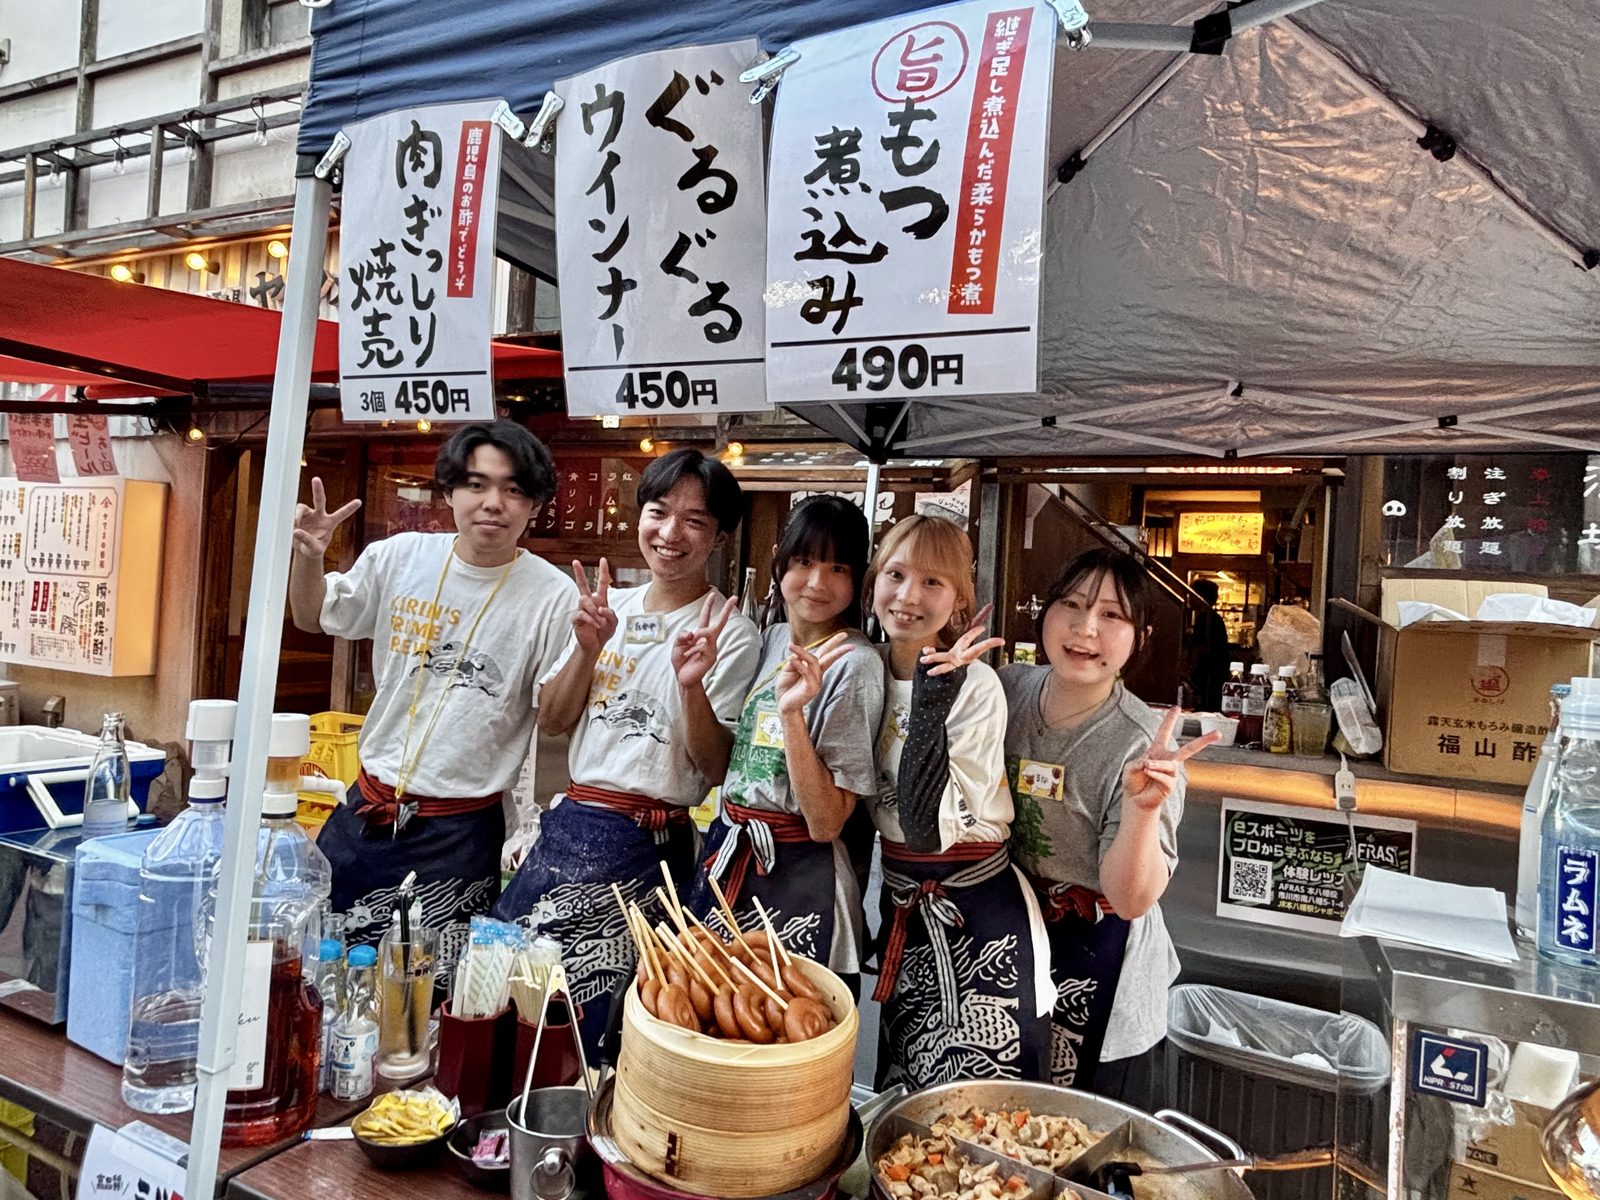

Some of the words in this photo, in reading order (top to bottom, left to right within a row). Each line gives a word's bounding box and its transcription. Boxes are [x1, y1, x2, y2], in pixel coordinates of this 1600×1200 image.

[879, 96, 950, 240] もつ
[960, 16, 1021, 306] 継ぎ足し煮込んだ柔らかもつ煮
[396, 119, 443, 369] 肉ぎっしり
[454, 127, 484, 292] 鹿児島のお酢でどうぞ
[580, 82, 638, 362] ウインナー
[645, 69, 743, 344] ぐるぐる
[794, 126, 889, 336] 煮込み
[348, 238, 404, 369] 焼売
[360, 390, 387, 414] 3個
[394, 379, 471, 415] 450円
[615, 370, 719, 410] 450円
[831, 343, 964, 392] 490円
[583, 472, 599, 531] コーラ
[603, 472, 618, 531] ラムネ
[1443, 466, 1468, 555] 割り放題
[1479, 466, 1508, 555] 注ぎ放題
[1437, 733, 1538, 762] 福山酢
[1233, 821, 1316, 844] eスポーツを
[1233, 837, 1334, 865] プロから学ぶなら
[1279, 883, 1305, 893] AFRAS
[1561, 858, 1590, 945] ラムネ
